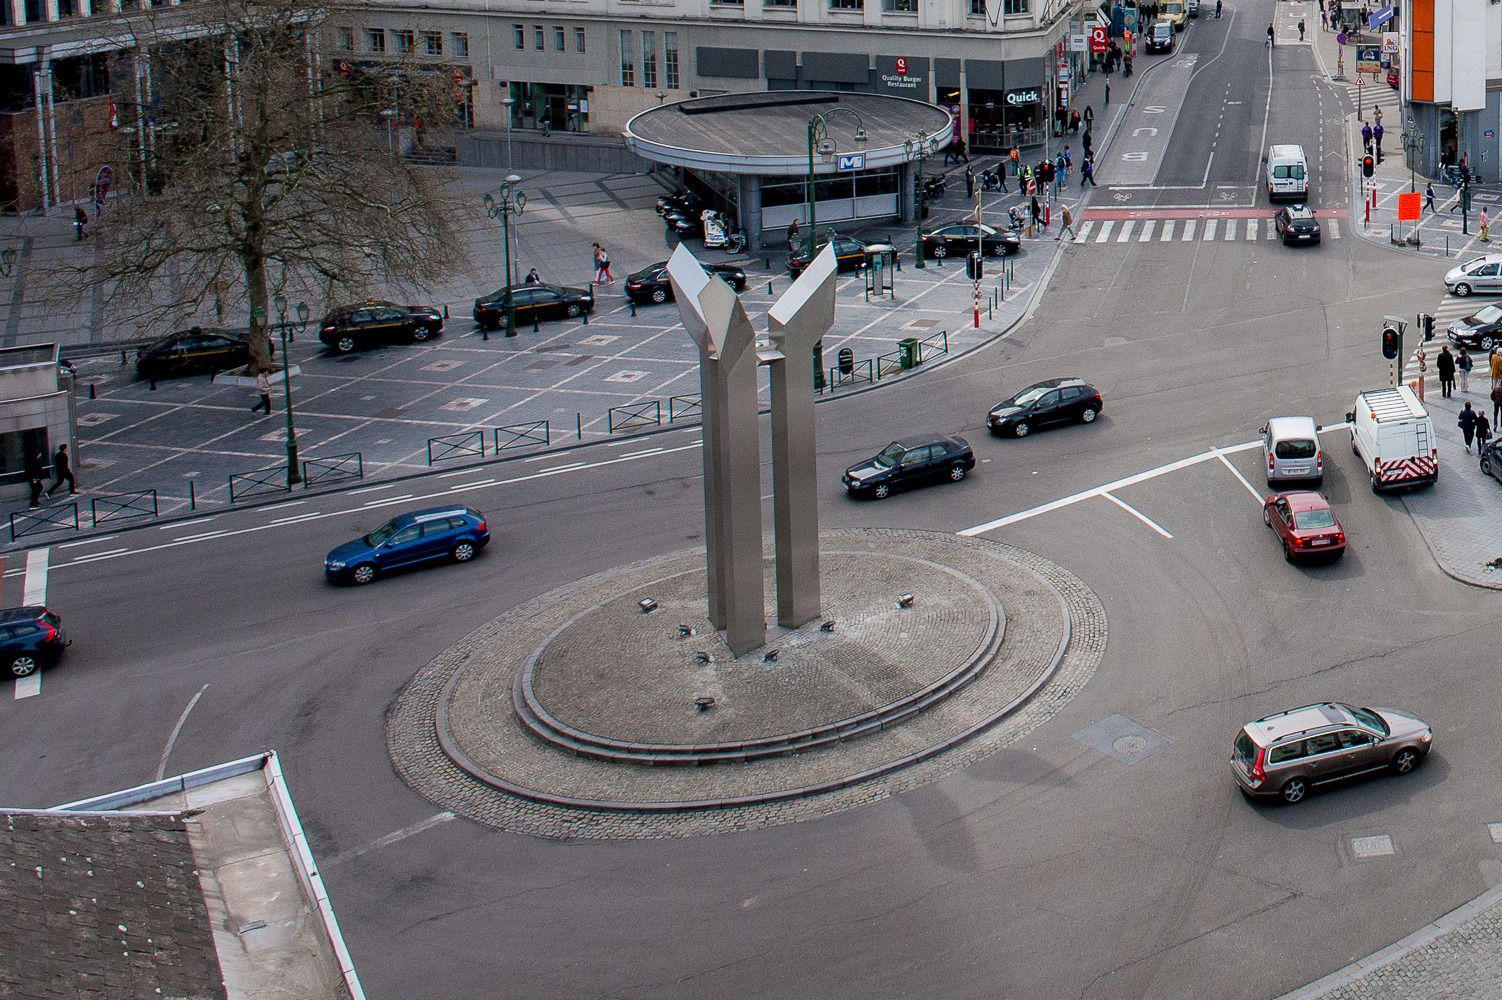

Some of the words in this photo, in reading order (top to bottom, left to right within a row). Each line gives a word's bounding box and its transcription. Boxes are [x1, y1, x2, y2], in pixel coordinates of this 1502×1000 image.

[1094, 30, 1105, 42] Q
[881, 74, 902, 83] Quality
[903, 74, 922, 84] Burger
[887, 81, 917, 89] Restaurant
[1007, 91, 1039, 105] Quick
